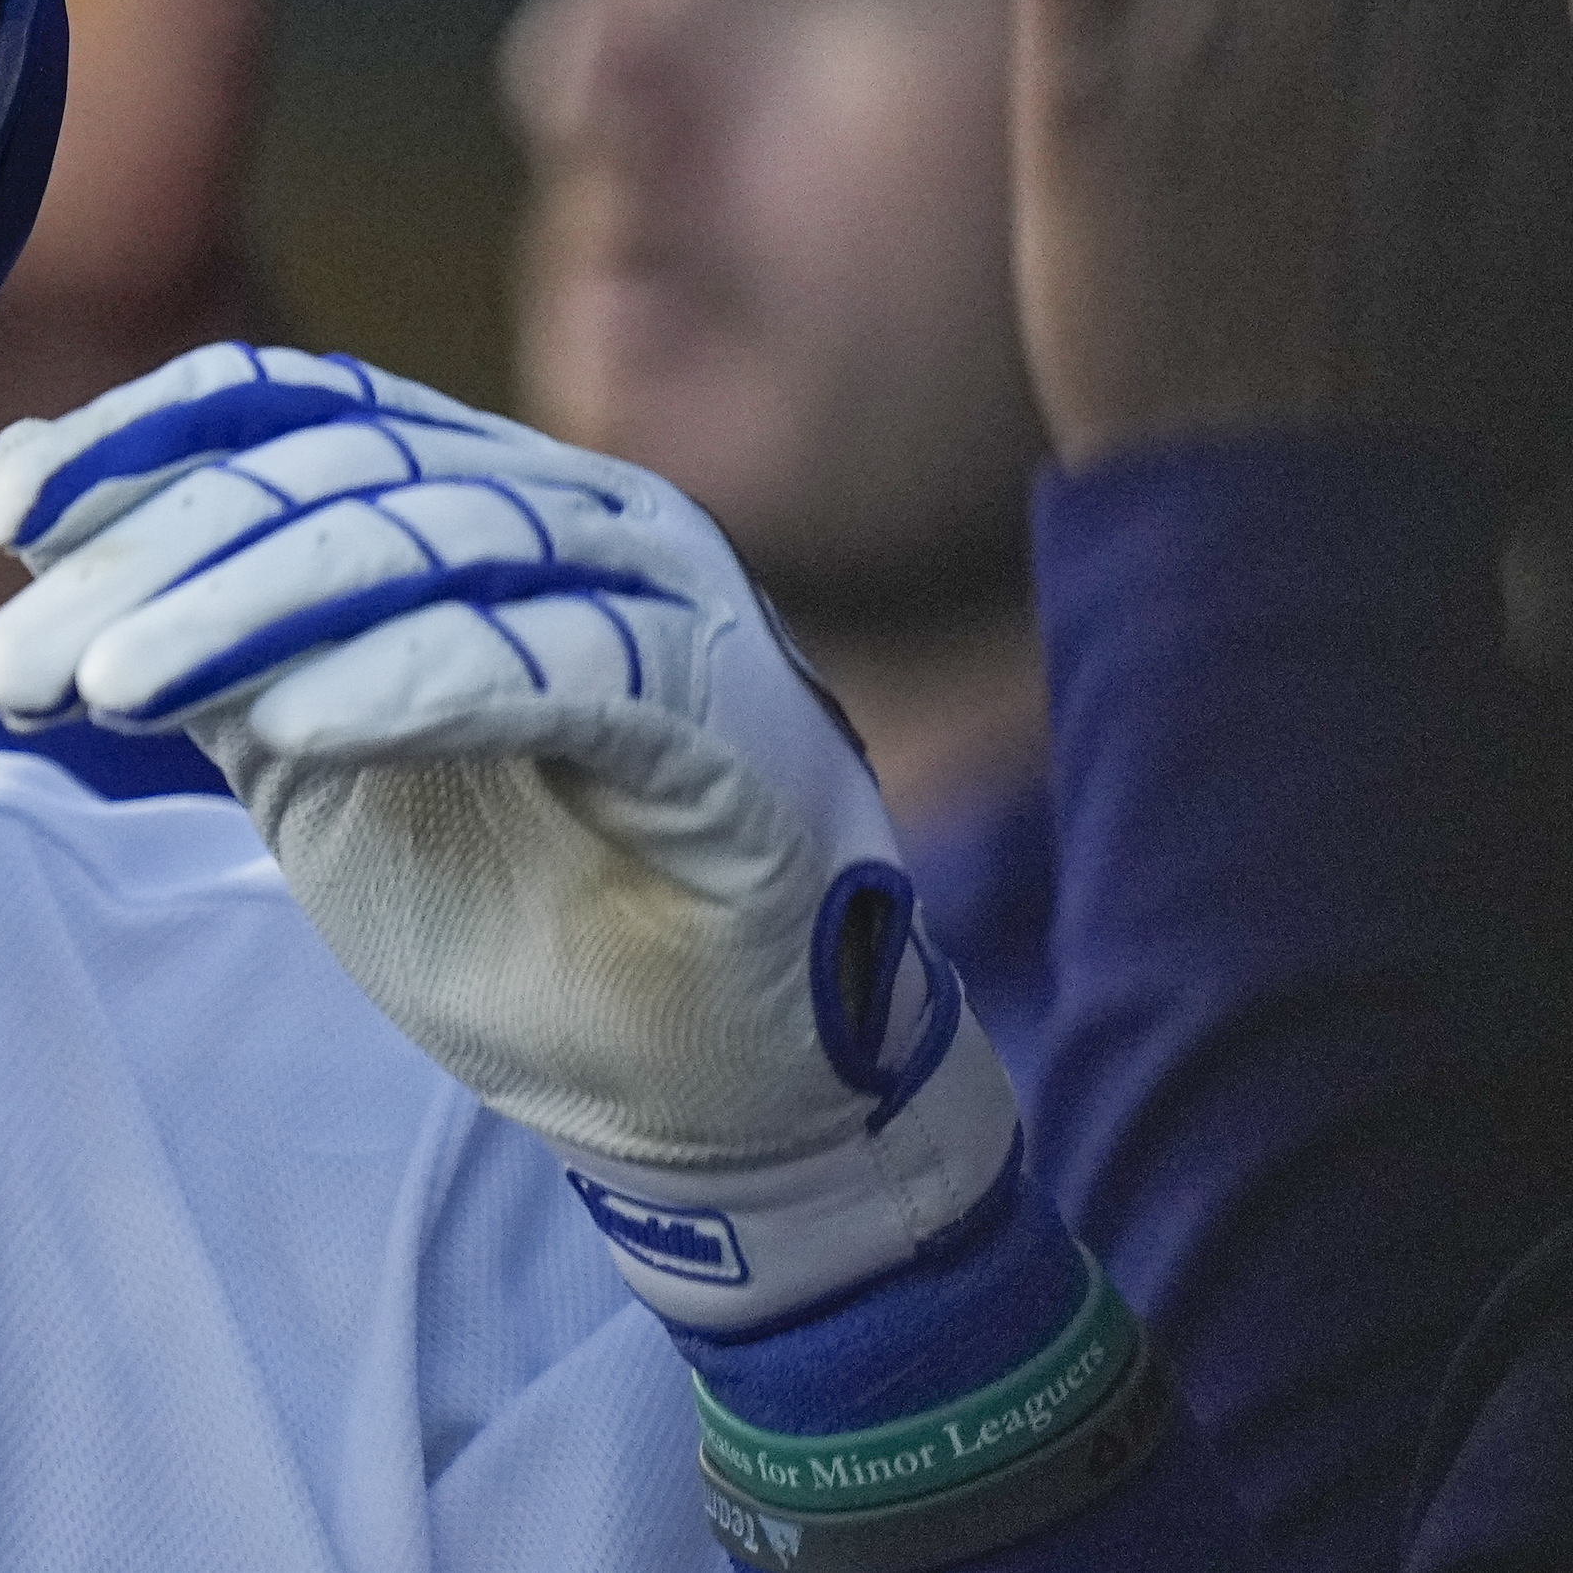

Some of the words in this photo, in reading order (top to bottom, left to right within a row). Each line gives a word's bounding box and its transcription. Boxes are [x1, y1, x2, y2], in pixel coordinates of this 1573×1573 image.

[757, 1450, 800, 1489] for
[808, 1443, 937, 1492] Minor
[943, 1339, 1105, 1460] Leaguers
